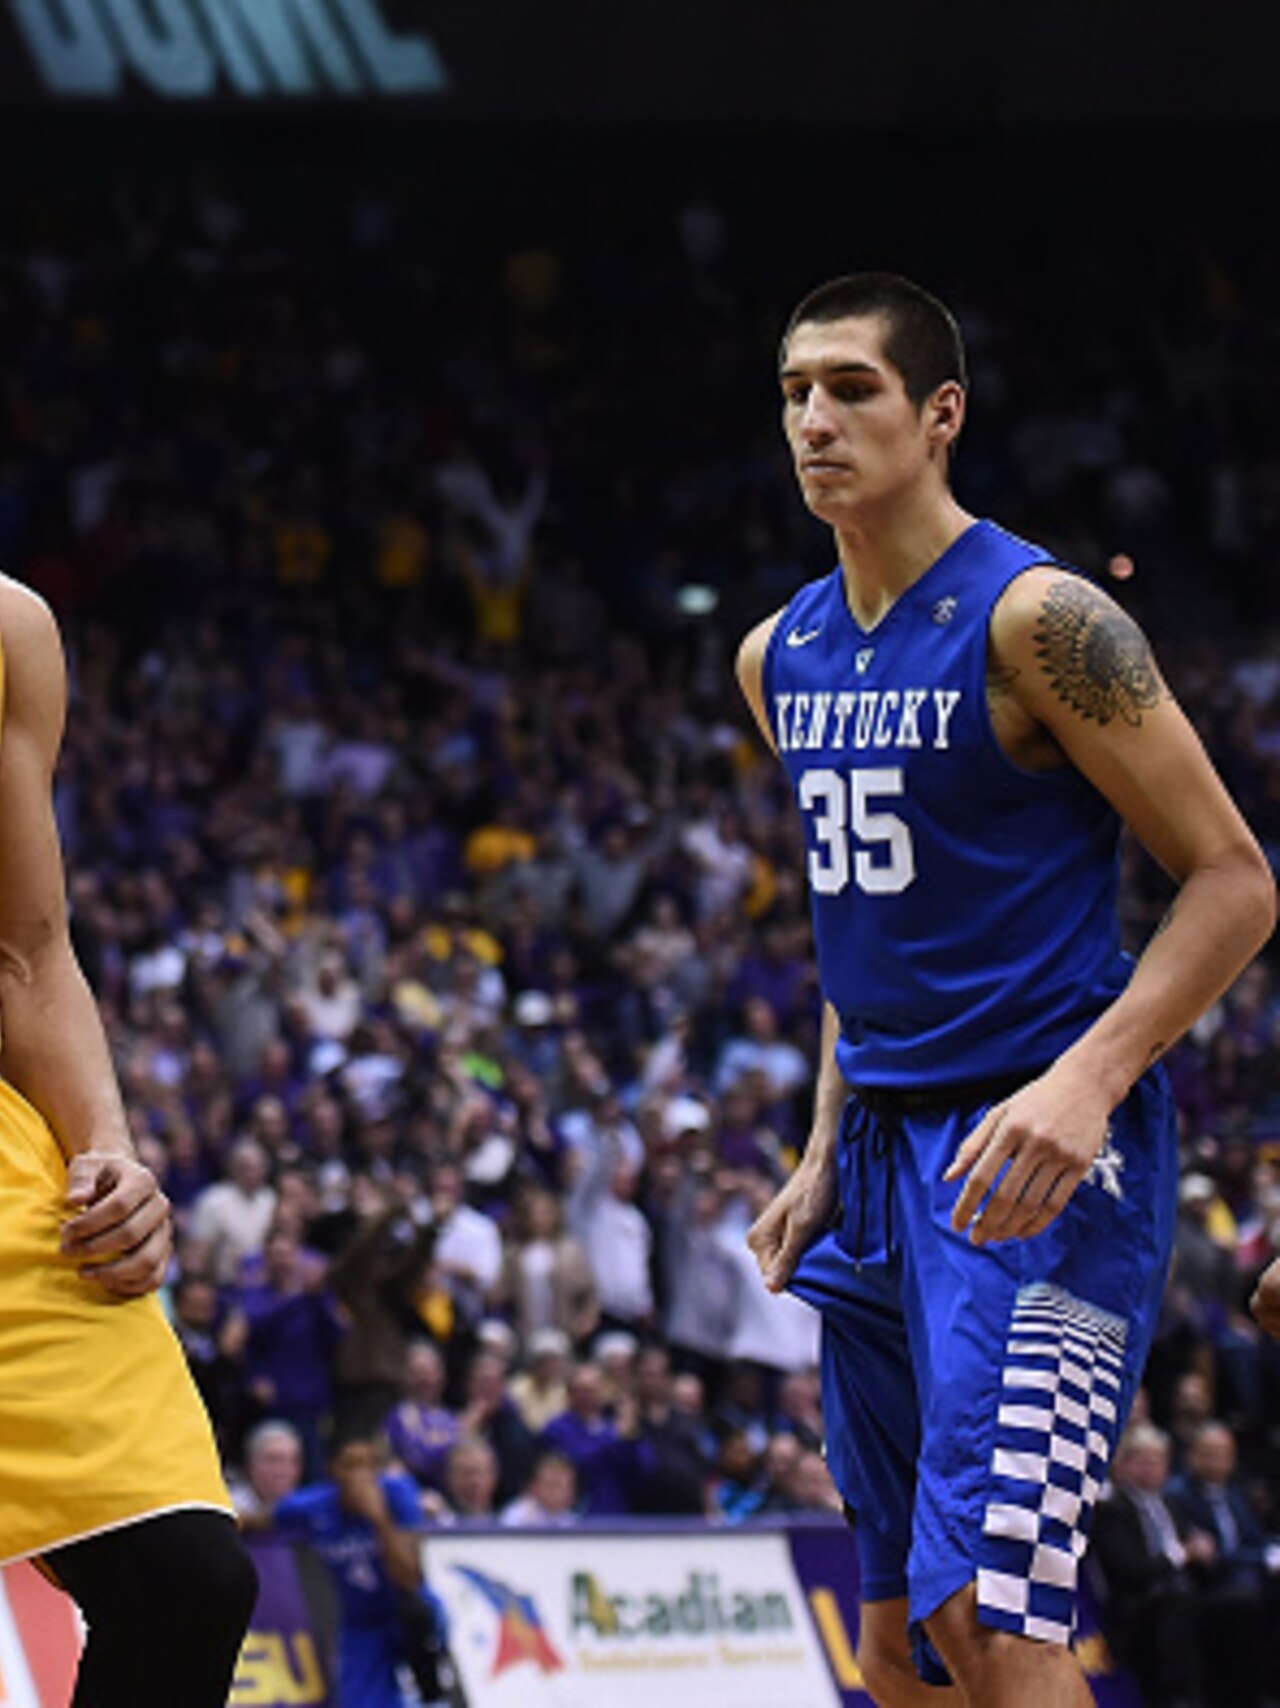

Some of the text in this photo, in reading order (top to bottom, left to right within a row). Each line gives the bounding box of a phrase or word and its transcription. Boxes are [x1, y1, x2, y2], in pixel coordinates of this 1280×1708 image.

[774, 688, 962, 753] KENTUCKY
[799, 767, 916, 895] 35
[569, 1571, 794, 1638] Acadian
